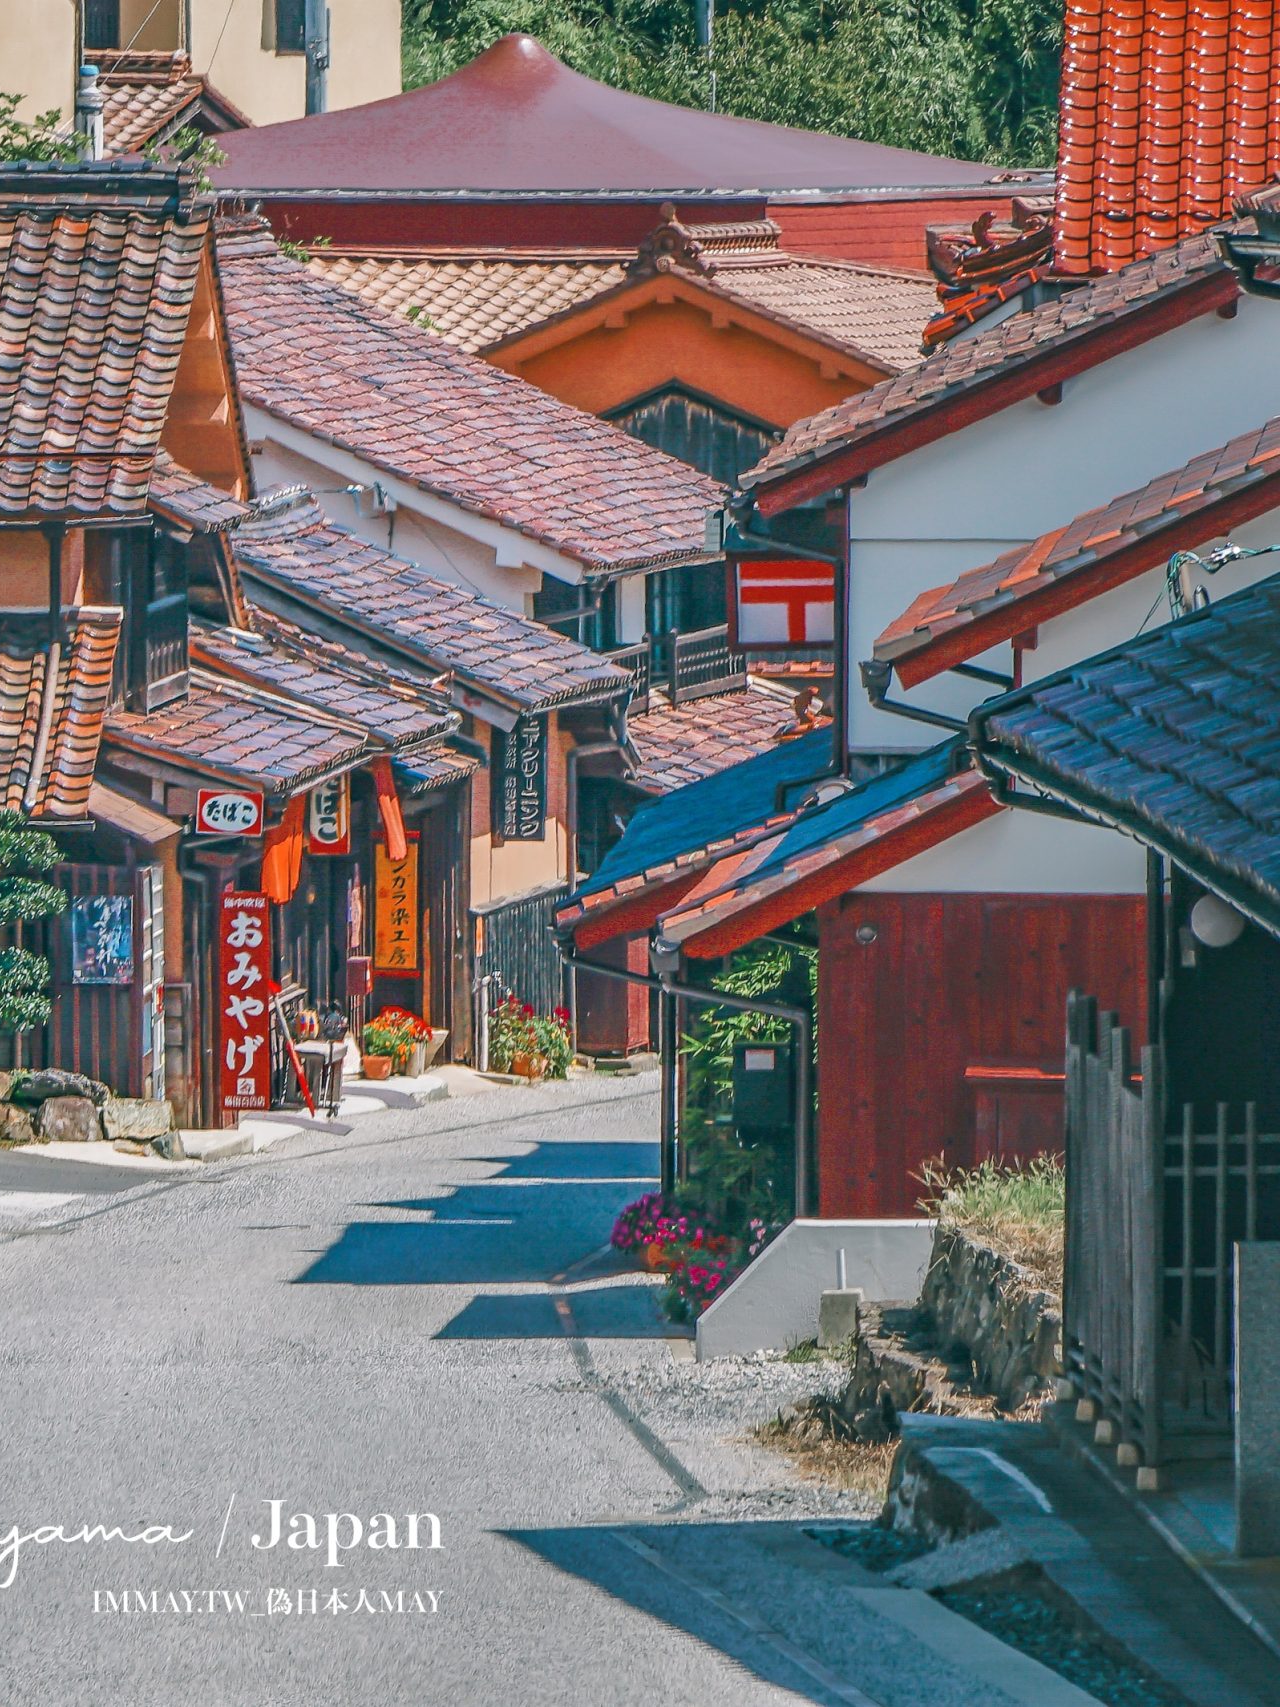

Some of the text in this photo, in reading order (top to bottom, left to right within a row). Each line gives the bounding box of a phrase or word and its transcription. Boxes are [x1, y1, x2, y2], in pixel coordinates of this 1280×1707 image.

[206, 800, 254, 825] たばこ
[387, 861, 411, 966] ンガラ染工房
[224, 910, 265, 1077] おみやげ
